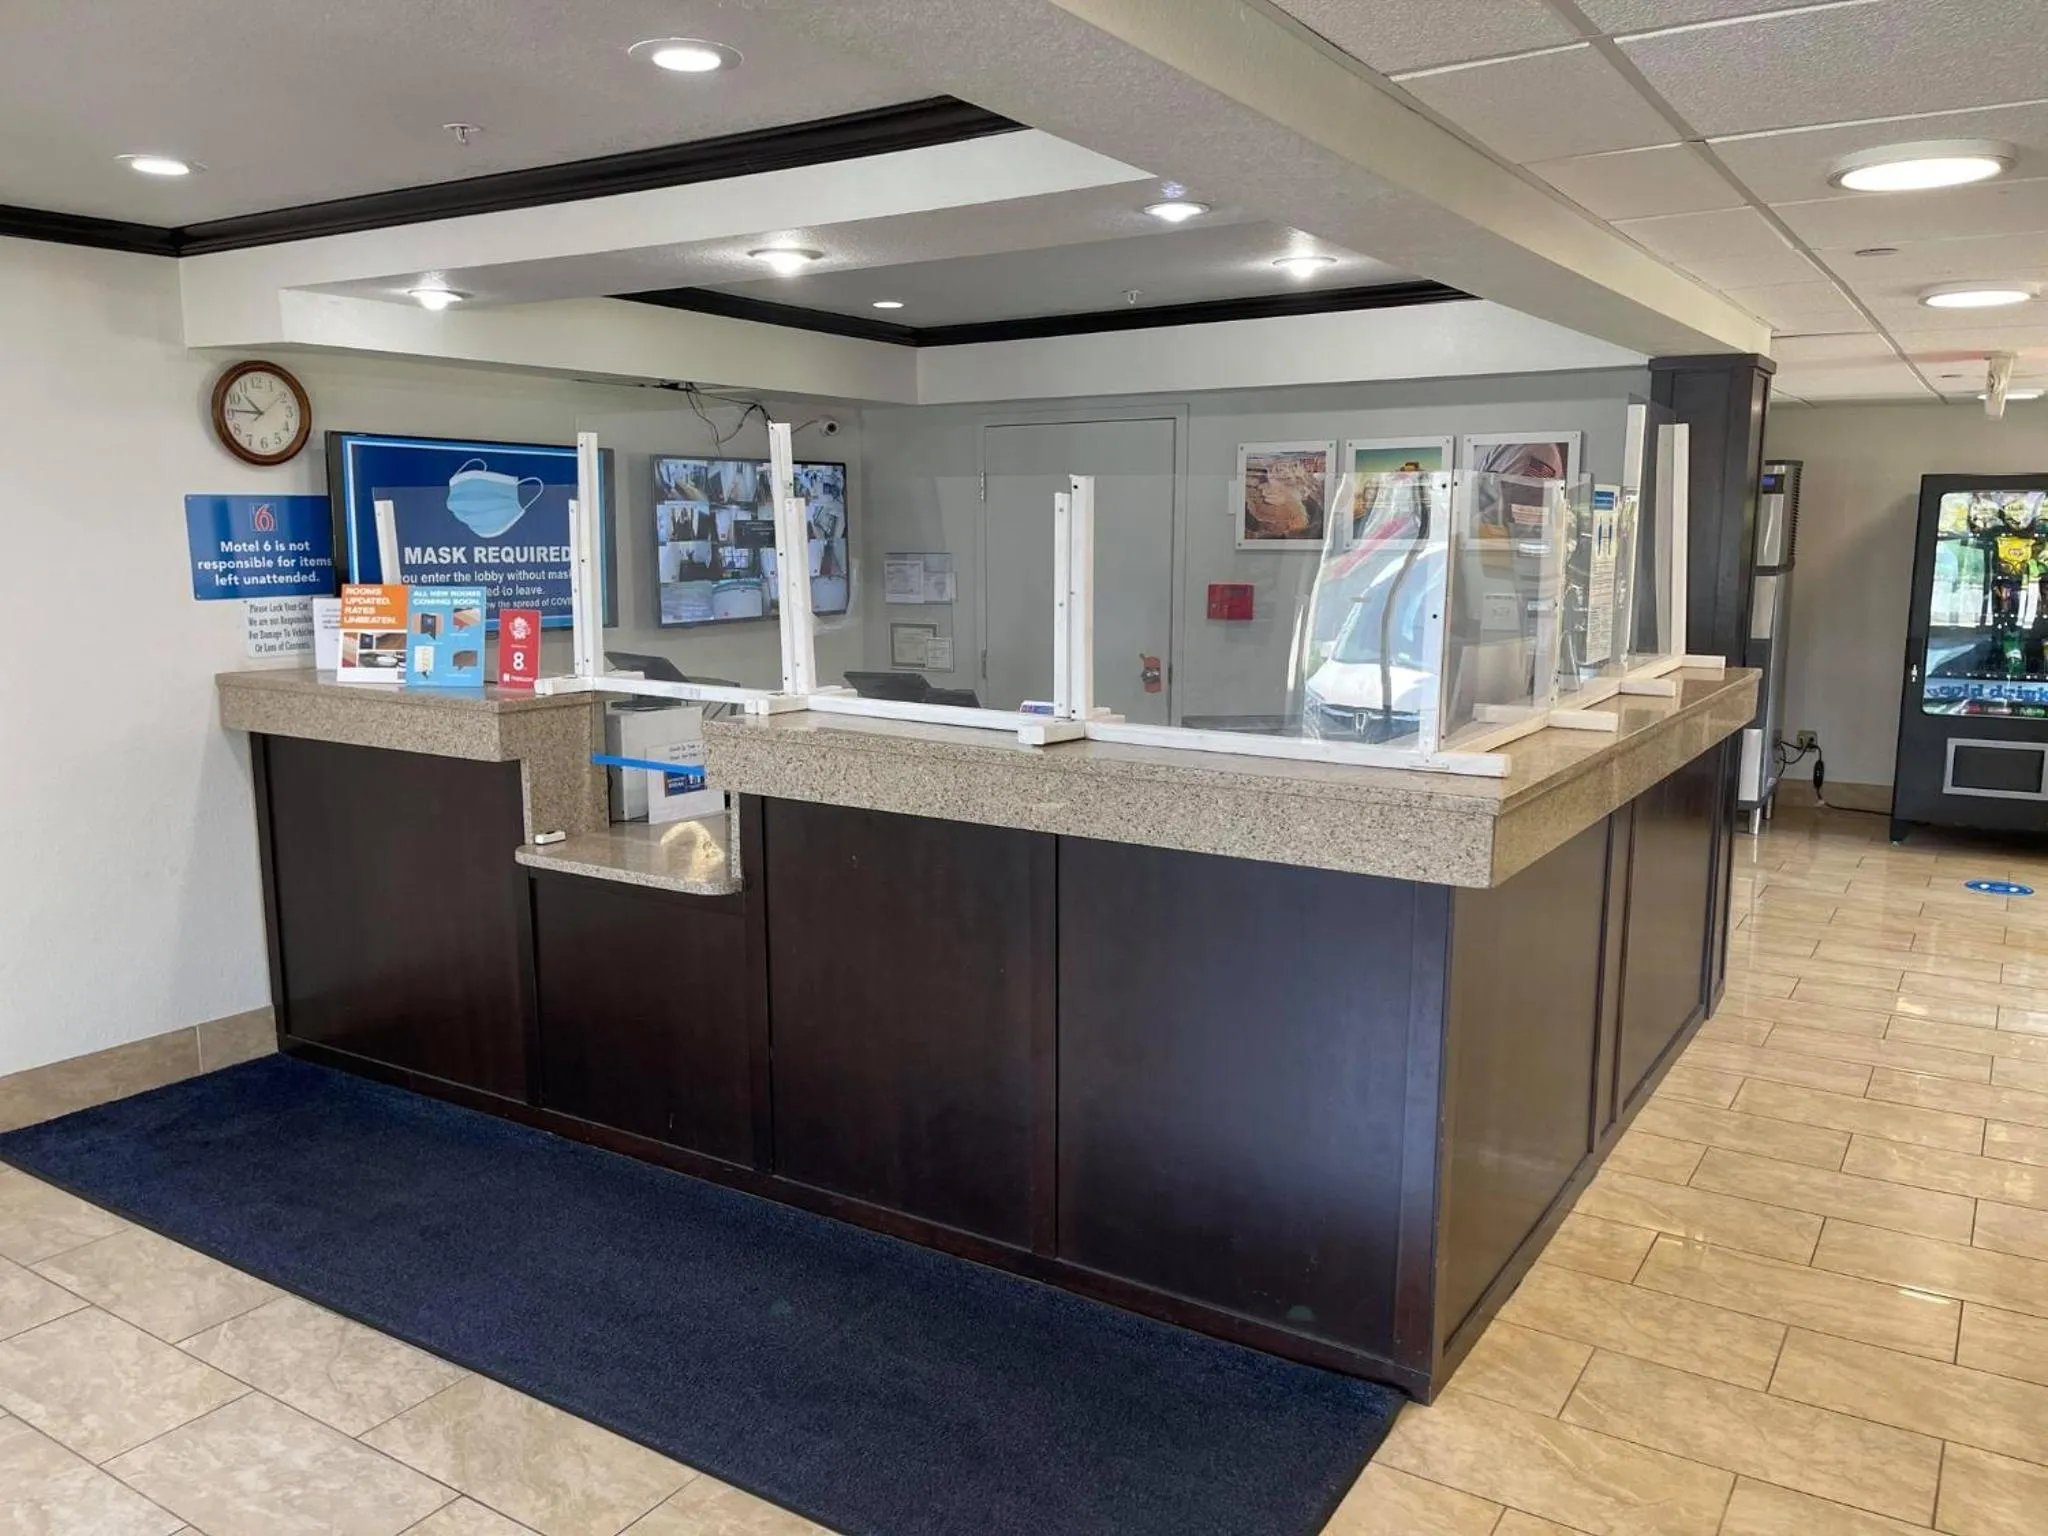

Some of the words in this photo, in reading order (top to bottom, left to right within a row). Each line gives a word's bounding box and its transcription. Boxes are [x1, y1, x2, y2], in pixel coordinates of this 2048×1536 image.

[250, 374, 263, 389] 12
[268, 379, 274, 392] 1
[228, 392, 241, 405] 10
[285, 405, 294, 419] 3
[233, 422, 242, 435] 8
[283, 420, 290, 433] 4
[245, 433, 254, 447] 7
[260, 437, 269, 449] 6
[274, 431, 282, 445] 5
[254, 503, 275, 532] 6
[220, 541, 260, 553] Motel
[262, 541, 272, 552] 6
[275, 540, 286, 552] is
[289, 540, 311, 552] not
[403, 546, 468, 564] MASK
[474, 545, 571, 564] REQUIRED
[197, 557, 274, 572] responsible
[277, 555, 296, 568] for
[299, 555, 333, 568] items
[215, 573, 240, 586] left
[242, 570, 320, 585] unattended.
[402, 574, 418, 584] ou
[421, 572, 451, 583] enter
[453, 570, 472, 583] the
[474, 570, 504, 585] lobby
[507, 568, 546, 581] without
[345, 587, 383, 596] ROOMS
[413, 590, 428, 598] ALL
[429, 590, 449, 598] NEW
[502, 586, 513, 597] to
[515, 585, 546, 596] leave.
[269, 602, 283, 612] Lock
[284, 602, 297, 611] Your
[345, 597, 392, 606] UPDATED.
[412, 598, 452, 606] COMING
[513, 599, 540, 611] spread
[541, 599, 549, 608] of
[344, 606, 377, 615] RATES
[513, 651, 525, 671] 8
